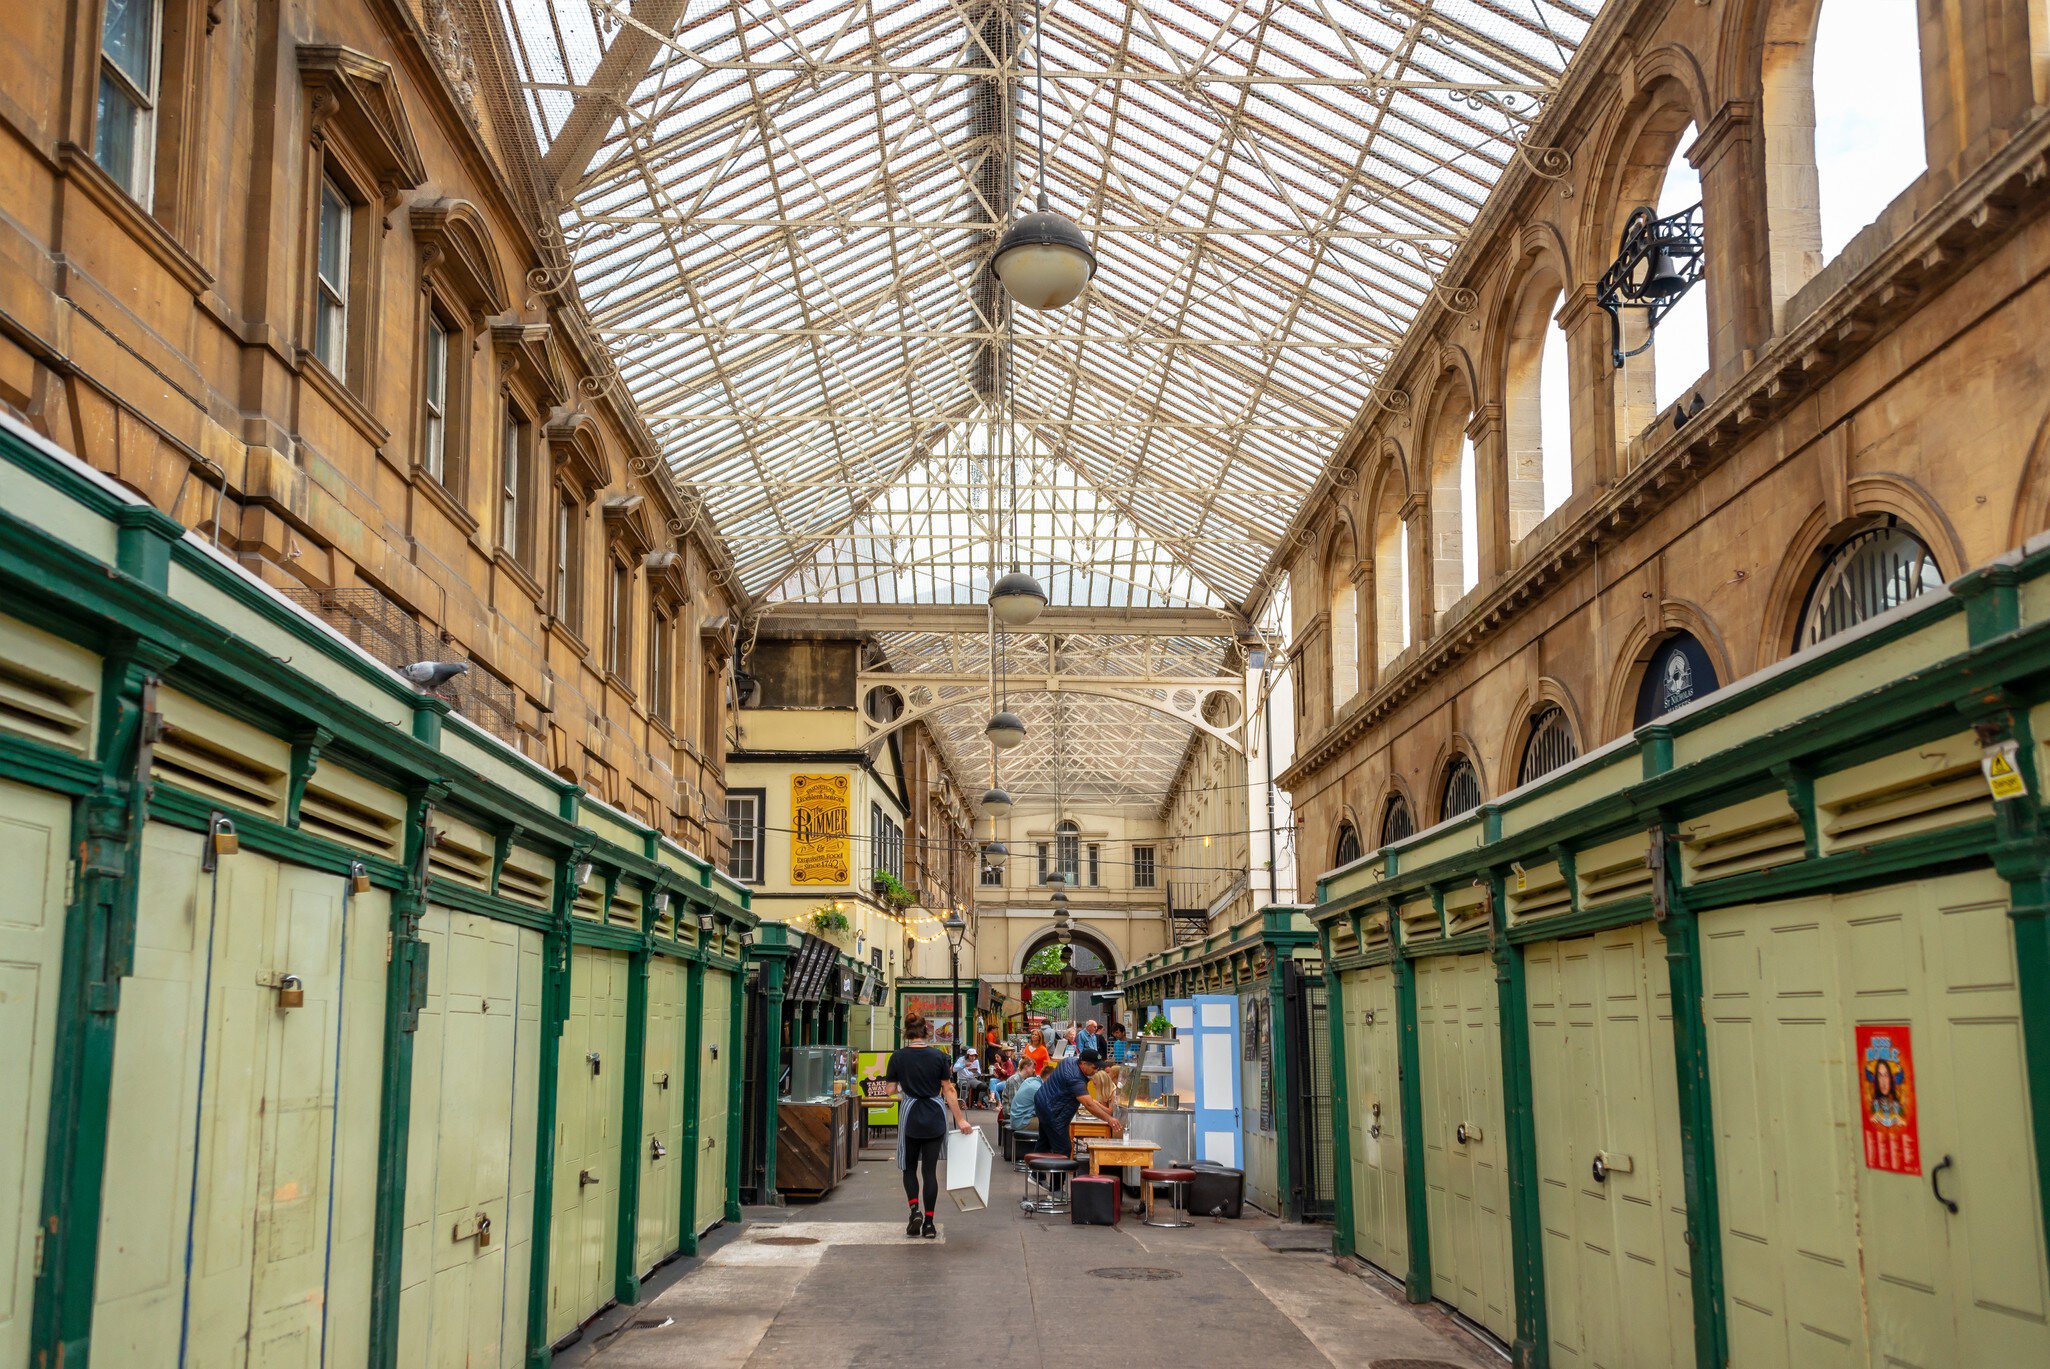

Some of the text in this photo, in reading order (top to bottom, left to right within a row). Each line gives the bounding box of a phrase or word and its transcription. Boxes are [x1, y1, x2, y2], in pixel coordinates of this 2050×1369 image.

[816, 843, 825, 852] &
[821, 859, 839, 869] 1742
[1028, 975, 1067, 989] FABRIC
